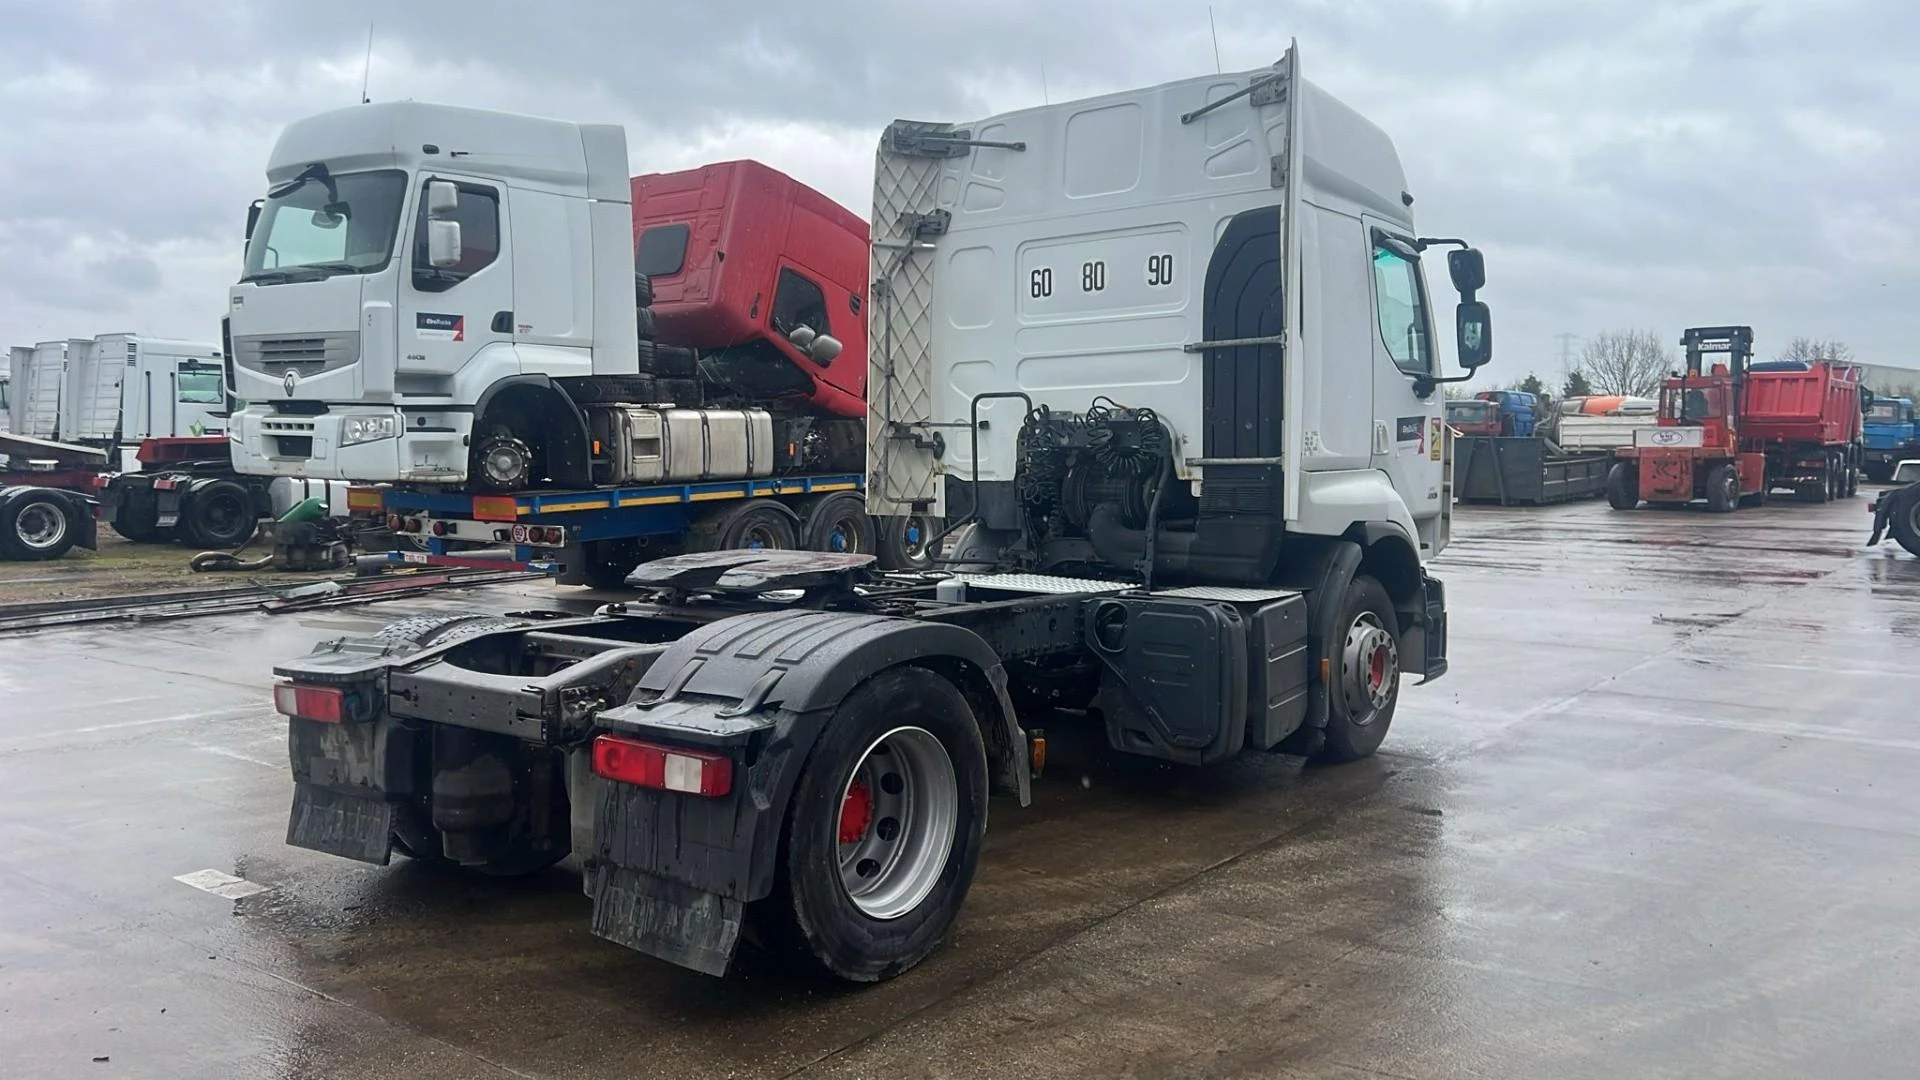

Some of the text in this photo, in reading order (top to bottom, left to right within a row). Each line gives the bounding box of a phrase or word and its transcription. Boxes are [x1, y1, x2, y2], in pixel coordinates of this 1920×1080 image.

[1031, 254, 1173, 298] 60 80 90
[1697, 342, 1732, 351] Kalmar
